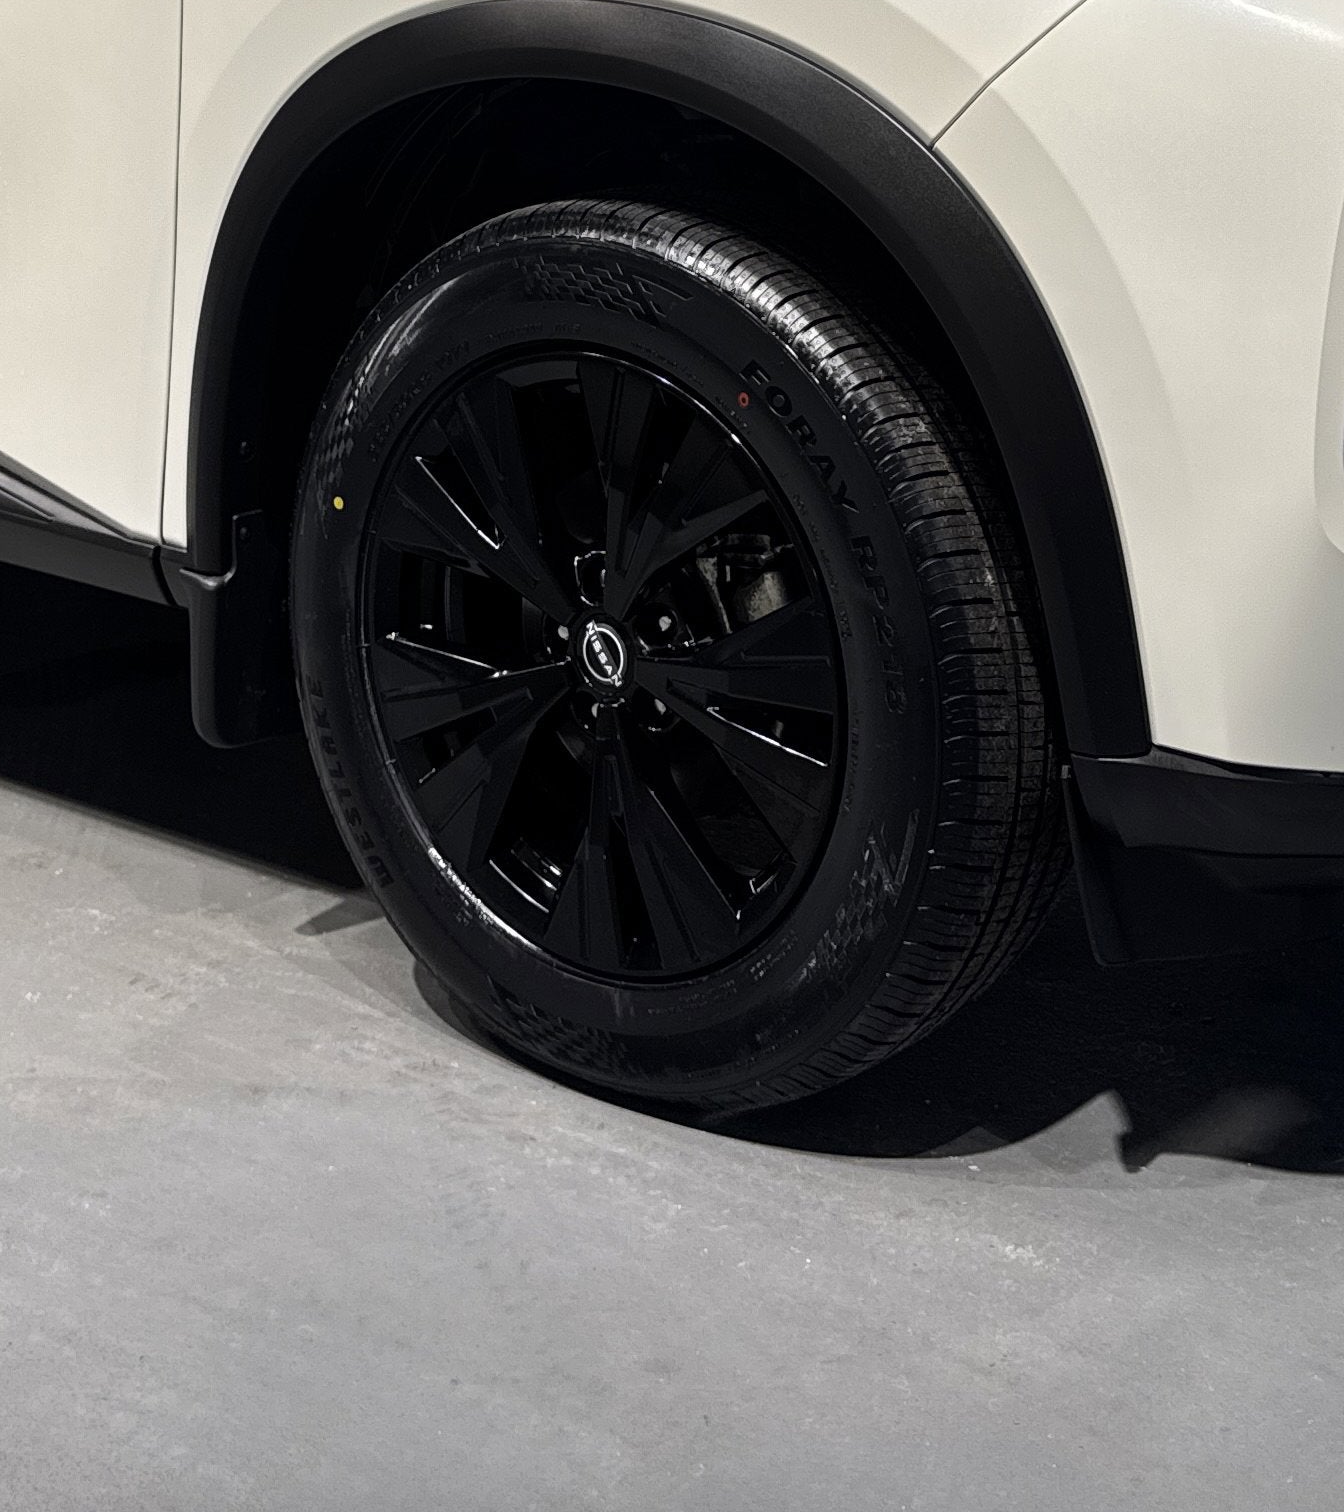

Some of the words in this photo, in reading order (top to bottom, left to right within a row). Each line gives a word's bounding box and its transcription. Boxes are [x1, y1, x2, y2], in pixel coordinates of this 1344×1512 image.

[739, 358, 860, 514] FORAY
[586, 620, 622, 687] NISSAN
[306, 674, 395, 888] WESTLAKE
